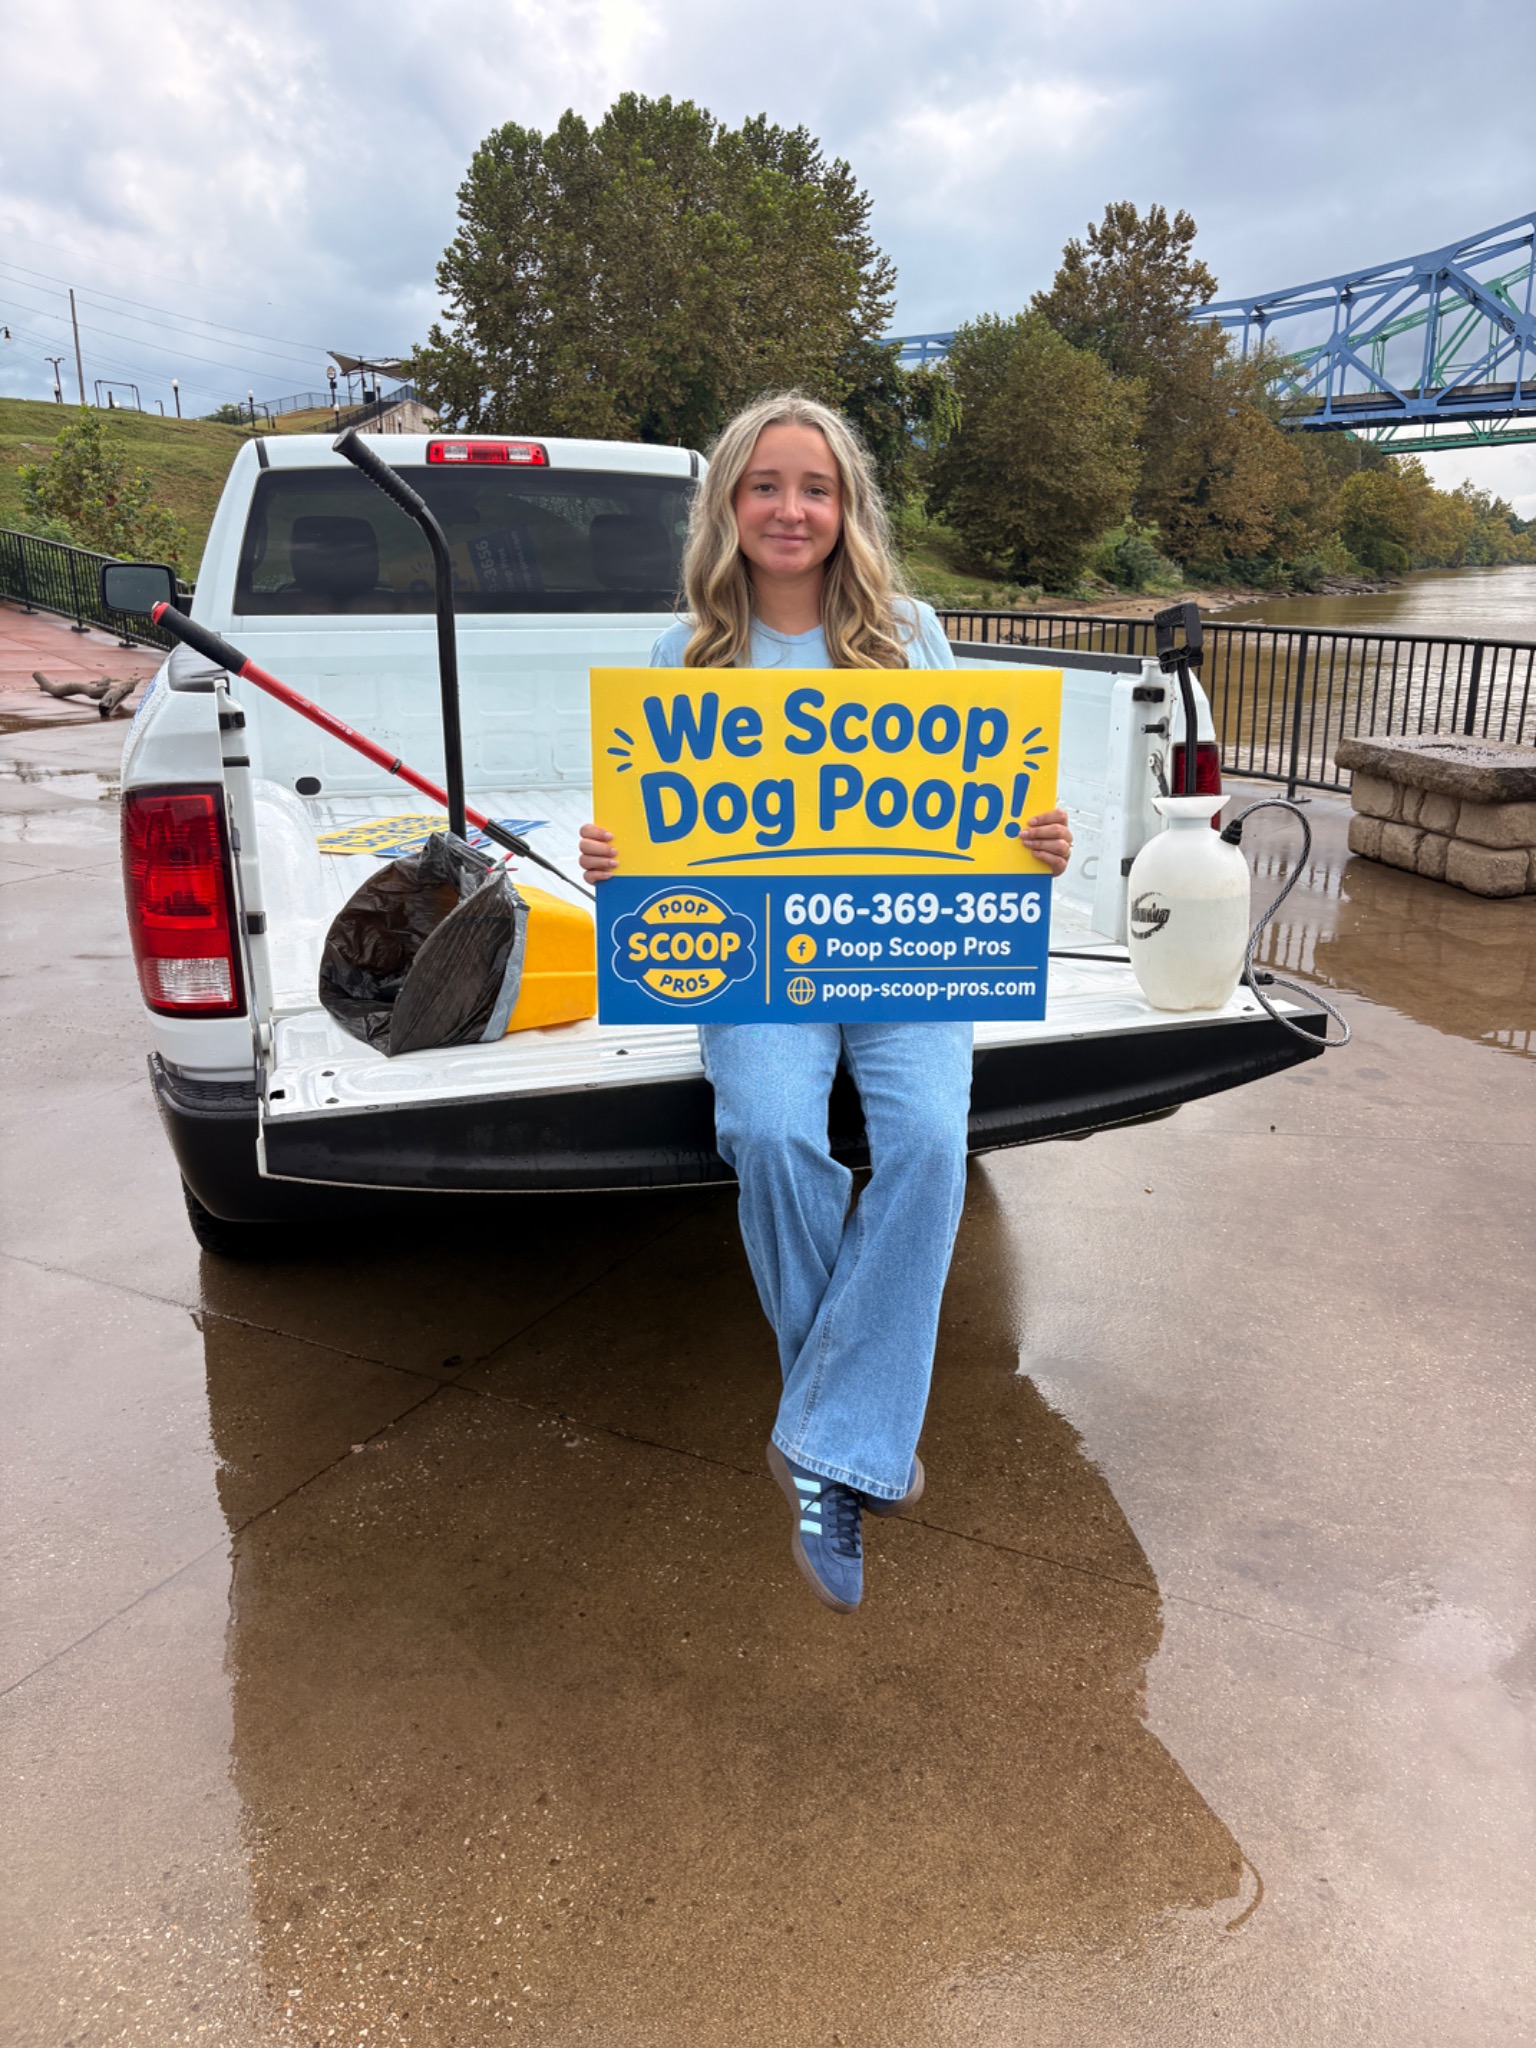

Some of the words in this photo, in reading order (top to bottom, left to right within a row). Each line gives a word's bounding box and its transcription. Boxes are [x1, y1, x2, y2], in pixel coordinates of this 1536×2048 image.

[643, 692, 763, 764] We
[784, 688, 1009, 773] Scoop
[640, 771, 795, 847] Dog
[818, 763, 1031, 850] Poop!
[658, 900, 709, 919] POOP
[784, 891, 1042, 925] 606-369-3656
[628, 931, 741, 962] SCOOP
[826, 938, 883, 961] Poop
[889, 937, 957, 960] Scoop
[963, 936, 1012, 956] Pros
[659, 974, 710, 994] PROS
[822, 981, 1036, 1001] poop-scoop-pros.com
